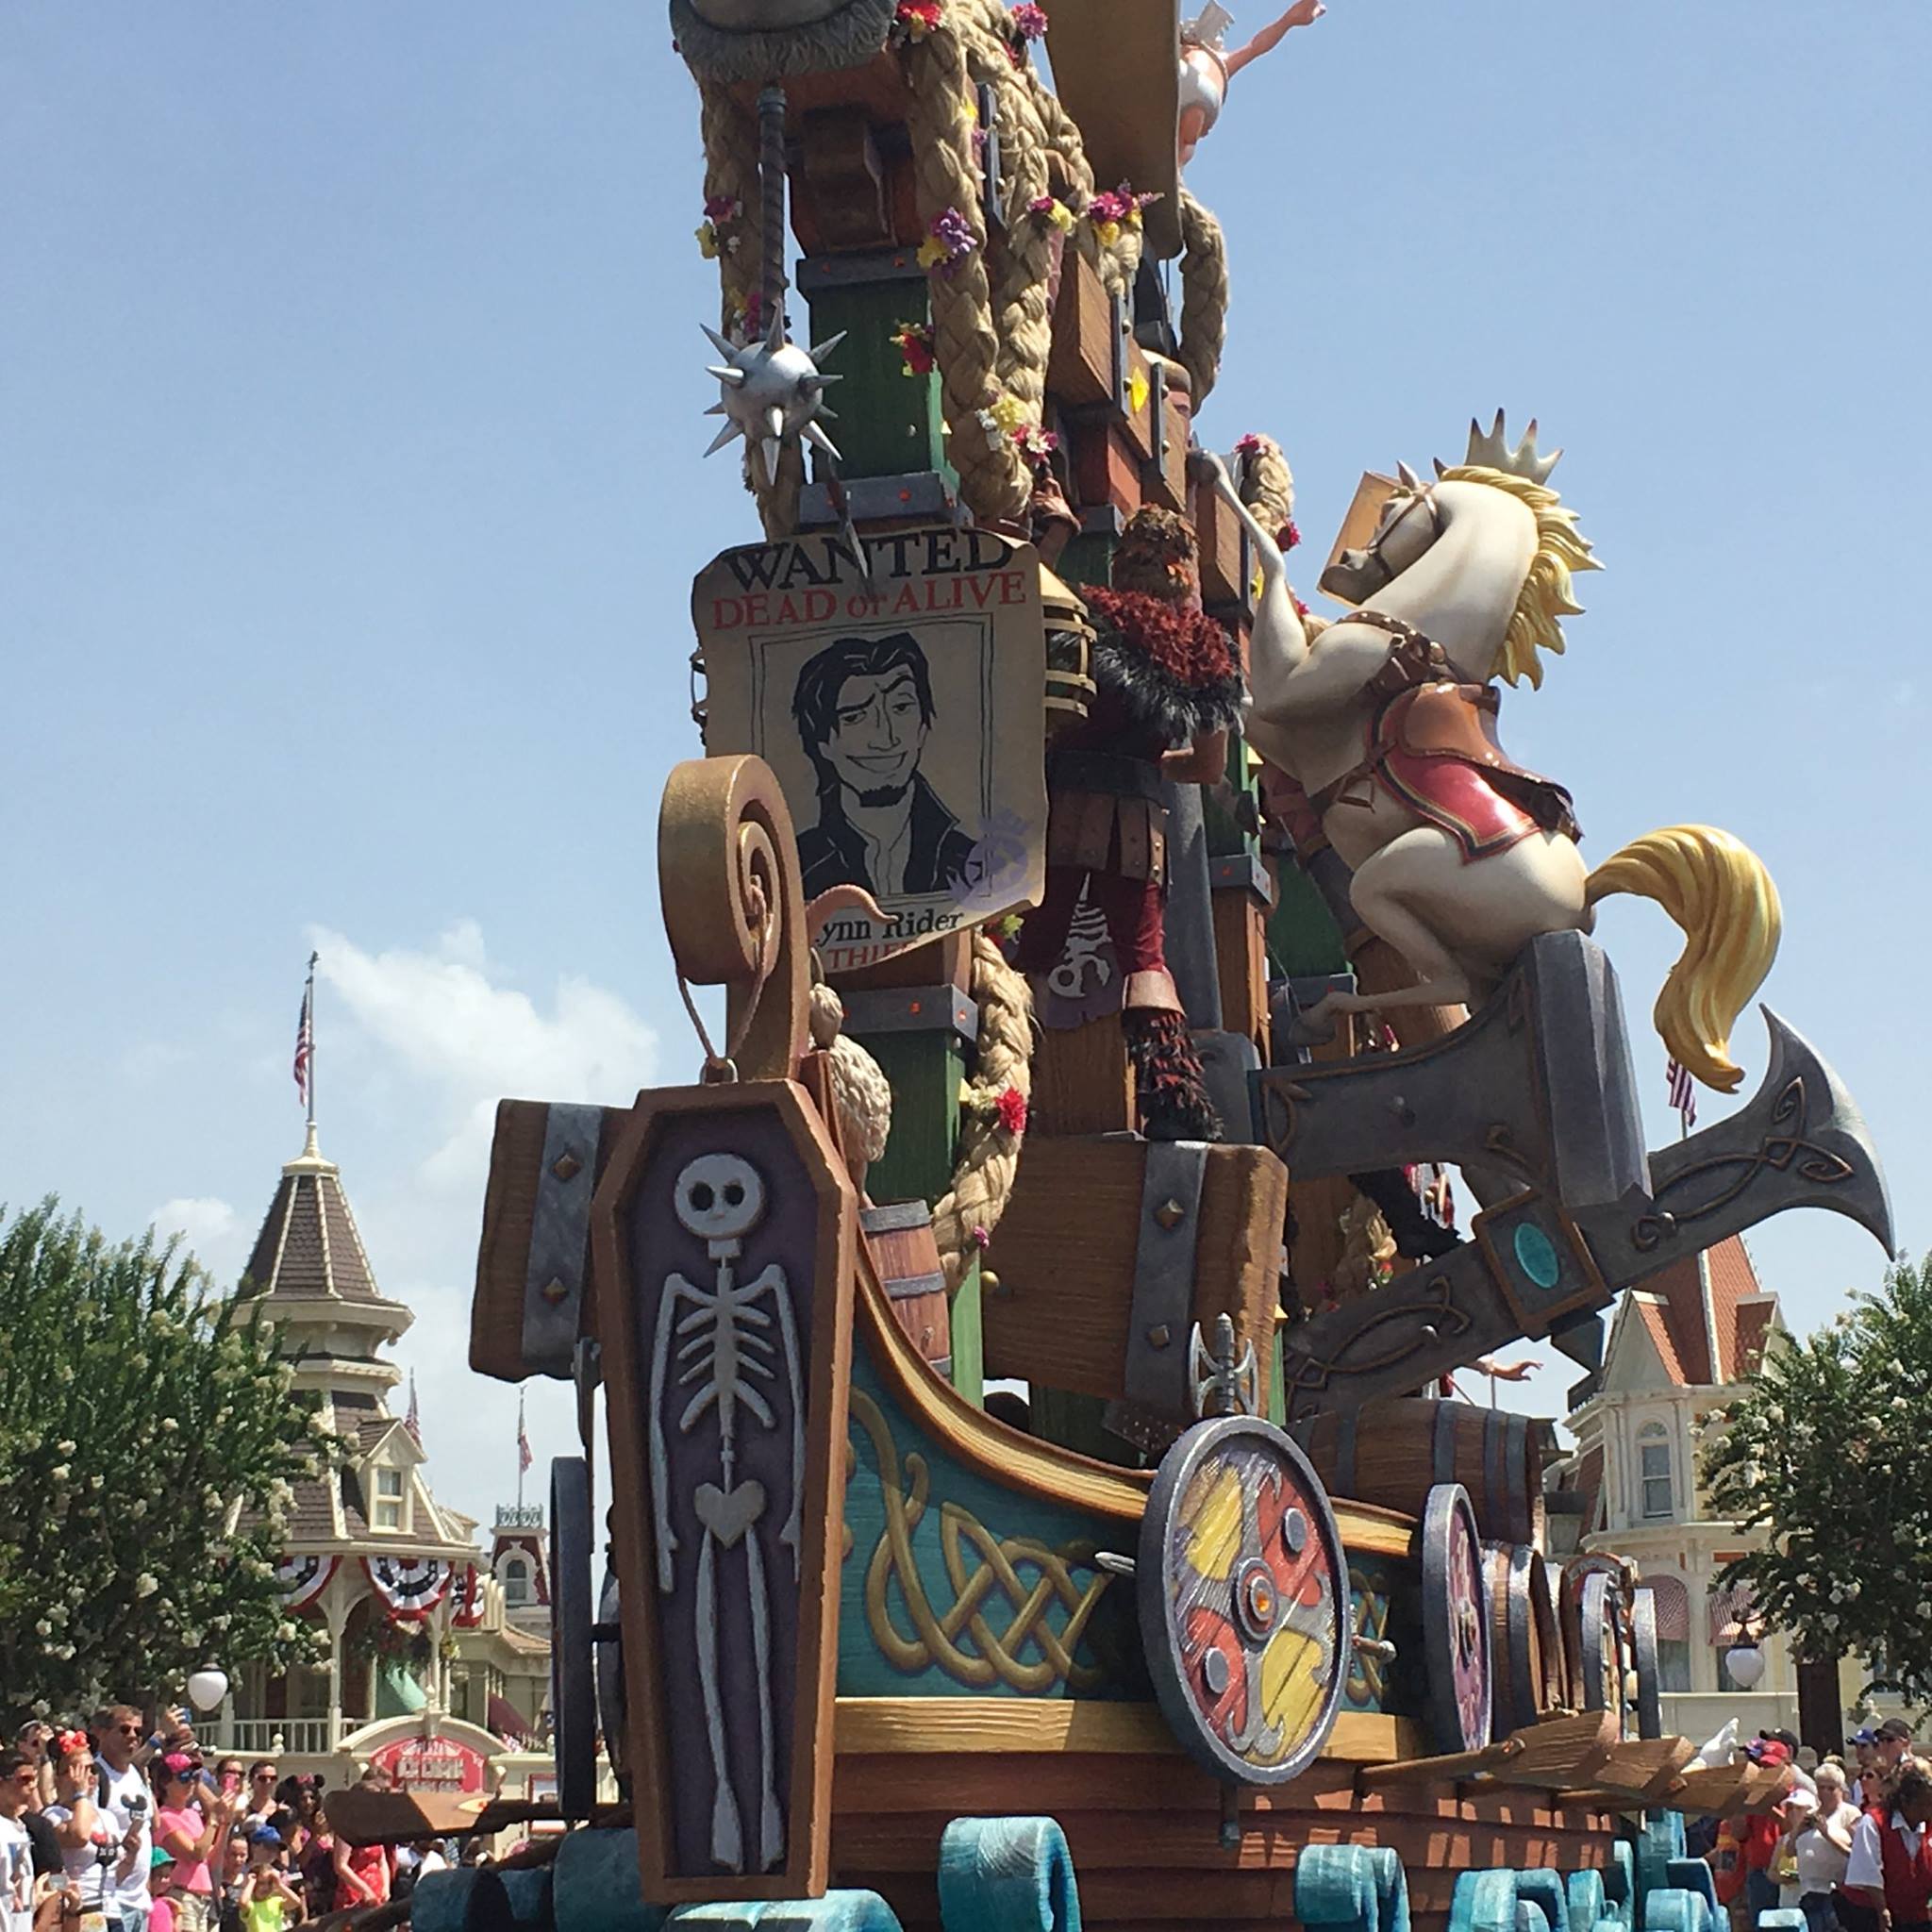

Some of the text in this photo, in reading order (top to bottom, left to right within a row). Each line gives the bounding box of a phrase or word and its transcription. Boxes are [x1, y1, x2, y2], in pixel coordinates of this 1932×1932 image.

[721, 526, 1014, 593] WANTED
[712, 570, 1027, 630] DEAD or ALIVE
[815, 908, 964, 949] ynn Rider
[826, 943, 908, 970] THIE
